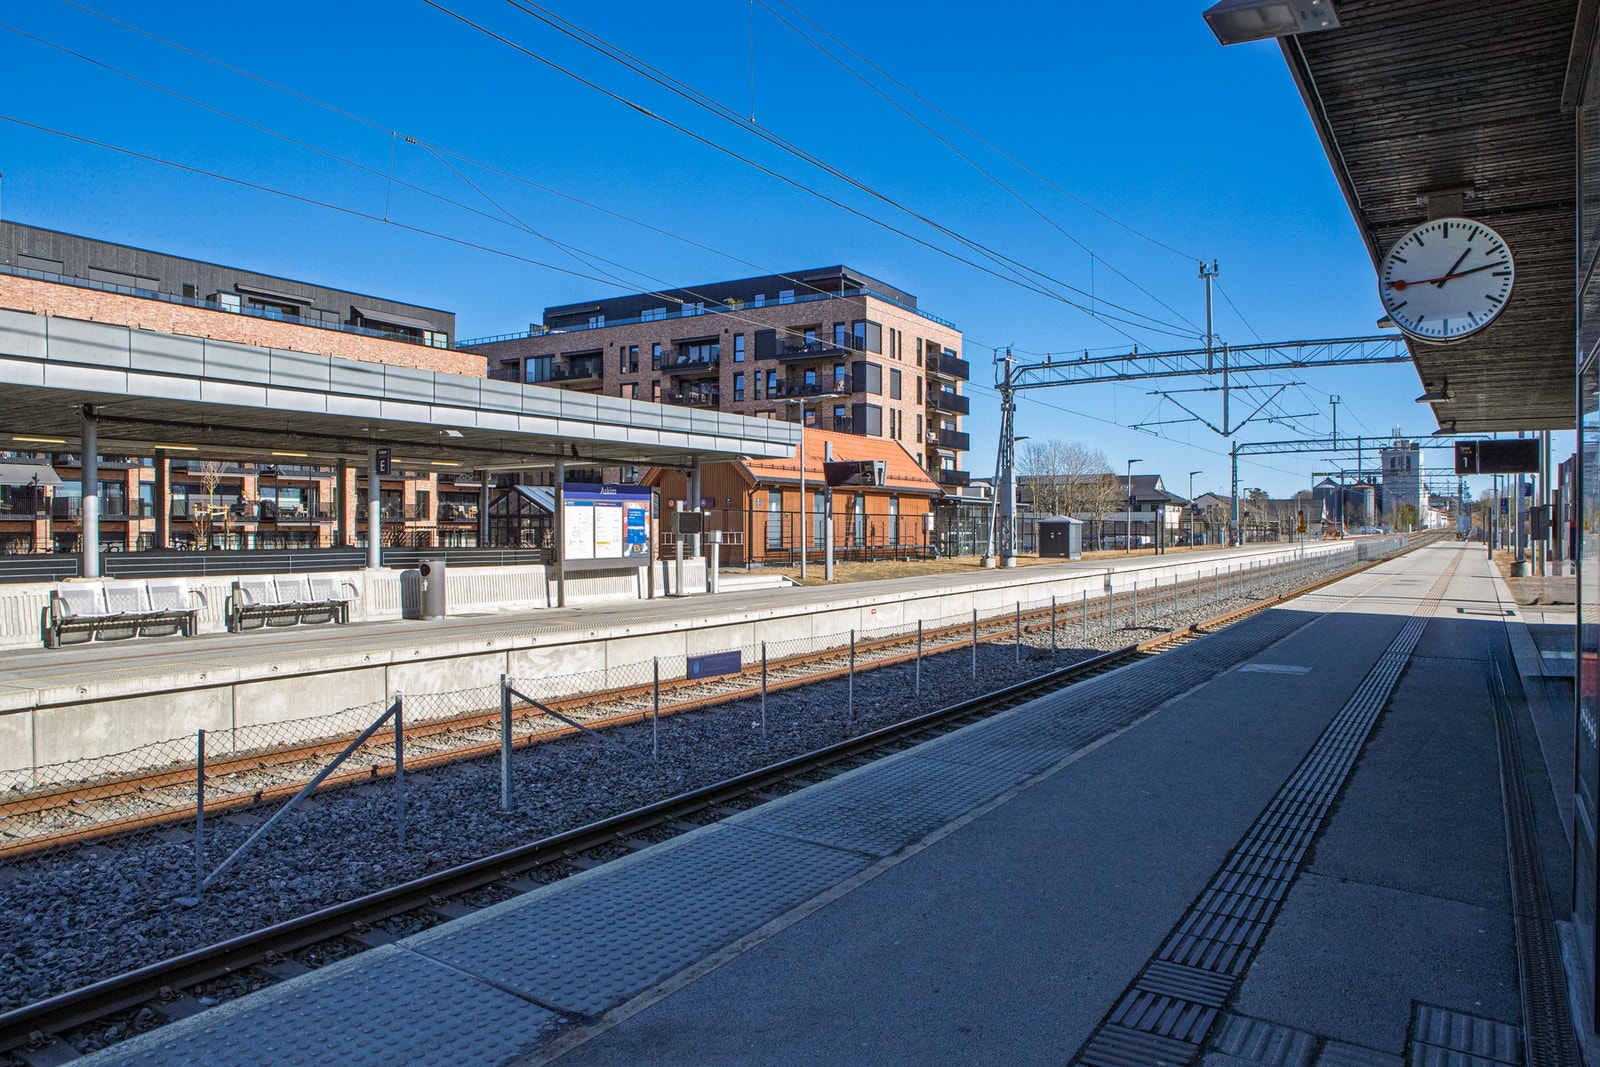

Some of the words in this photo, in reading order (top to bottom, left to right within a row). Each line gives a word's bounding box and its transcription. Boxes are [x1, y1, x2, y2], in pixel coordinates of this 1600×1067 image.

[380, 460, 386, 472] E
[1462, 456, 1468, 468] 1
[866, 472, 872, 482] 2
[600, 486, 617, 495] Askim
